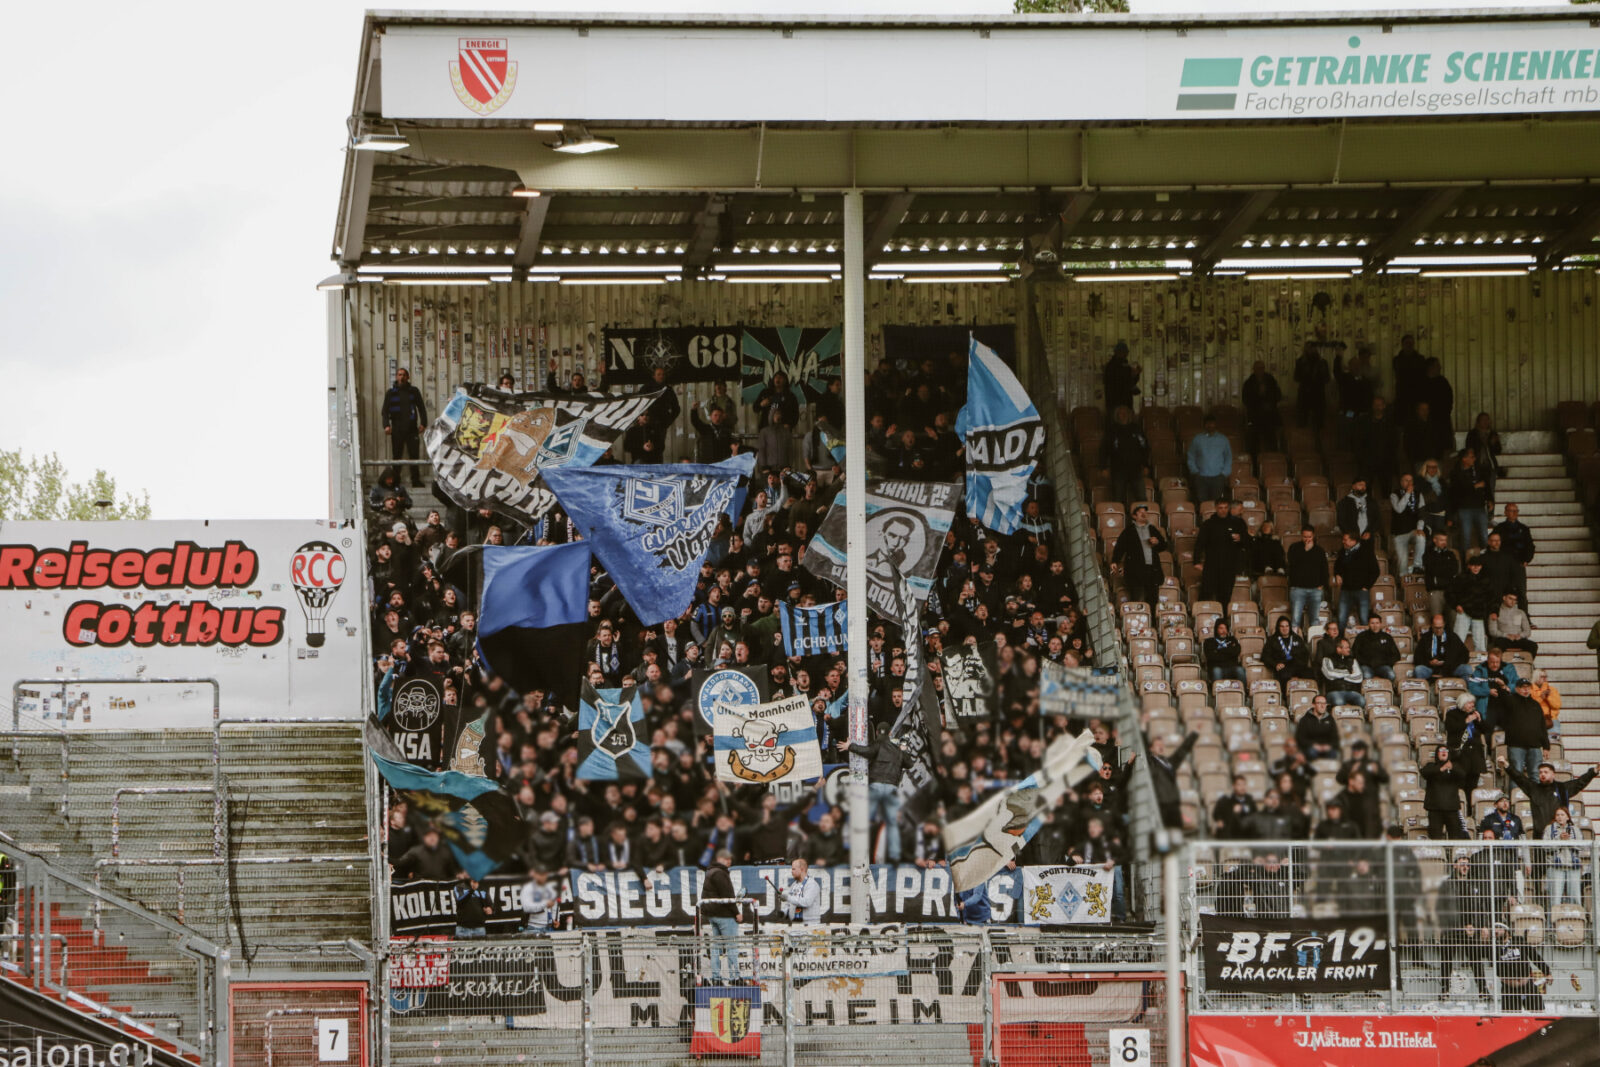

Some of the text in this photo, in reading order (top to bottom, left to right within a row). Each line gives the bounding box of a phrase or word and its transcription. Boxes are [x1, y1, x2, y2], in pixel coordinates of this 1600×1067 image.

[1245, 86, 1555, 114] Fachgroßhandelsgesellschaft
[687, 333, 738, 369] 68
[660, 505, 674, 518] 07
[0, 541, 257, 590] Reiseclub
[292, 553, 344, 587] RCC
[63, 600, 286, 648] Cottbus
[701, 673, 729, 701] WALDHOF
[732, 673, 757, 705] MANNHE
[748, 700, 805, 719] Mannheim
[1038, 866, 1098, 879] SPORTVEREIN
[577, 869, 672, 920] SIEG
[895, 867, 1015, 921] PRS
[390, 966, 449, 987] WORMS
[779, 960, 870, 971] SADIONVERBOT
[1220, 964, 1378, 981] BARACKLER FRONT
[630, 997, 943, 1028] MNHEIM
[328, 1029, 340, 1051] 7
[1121, 1036, 1138, 1063] 8
[1365, 1032, 1376, 1048] &
